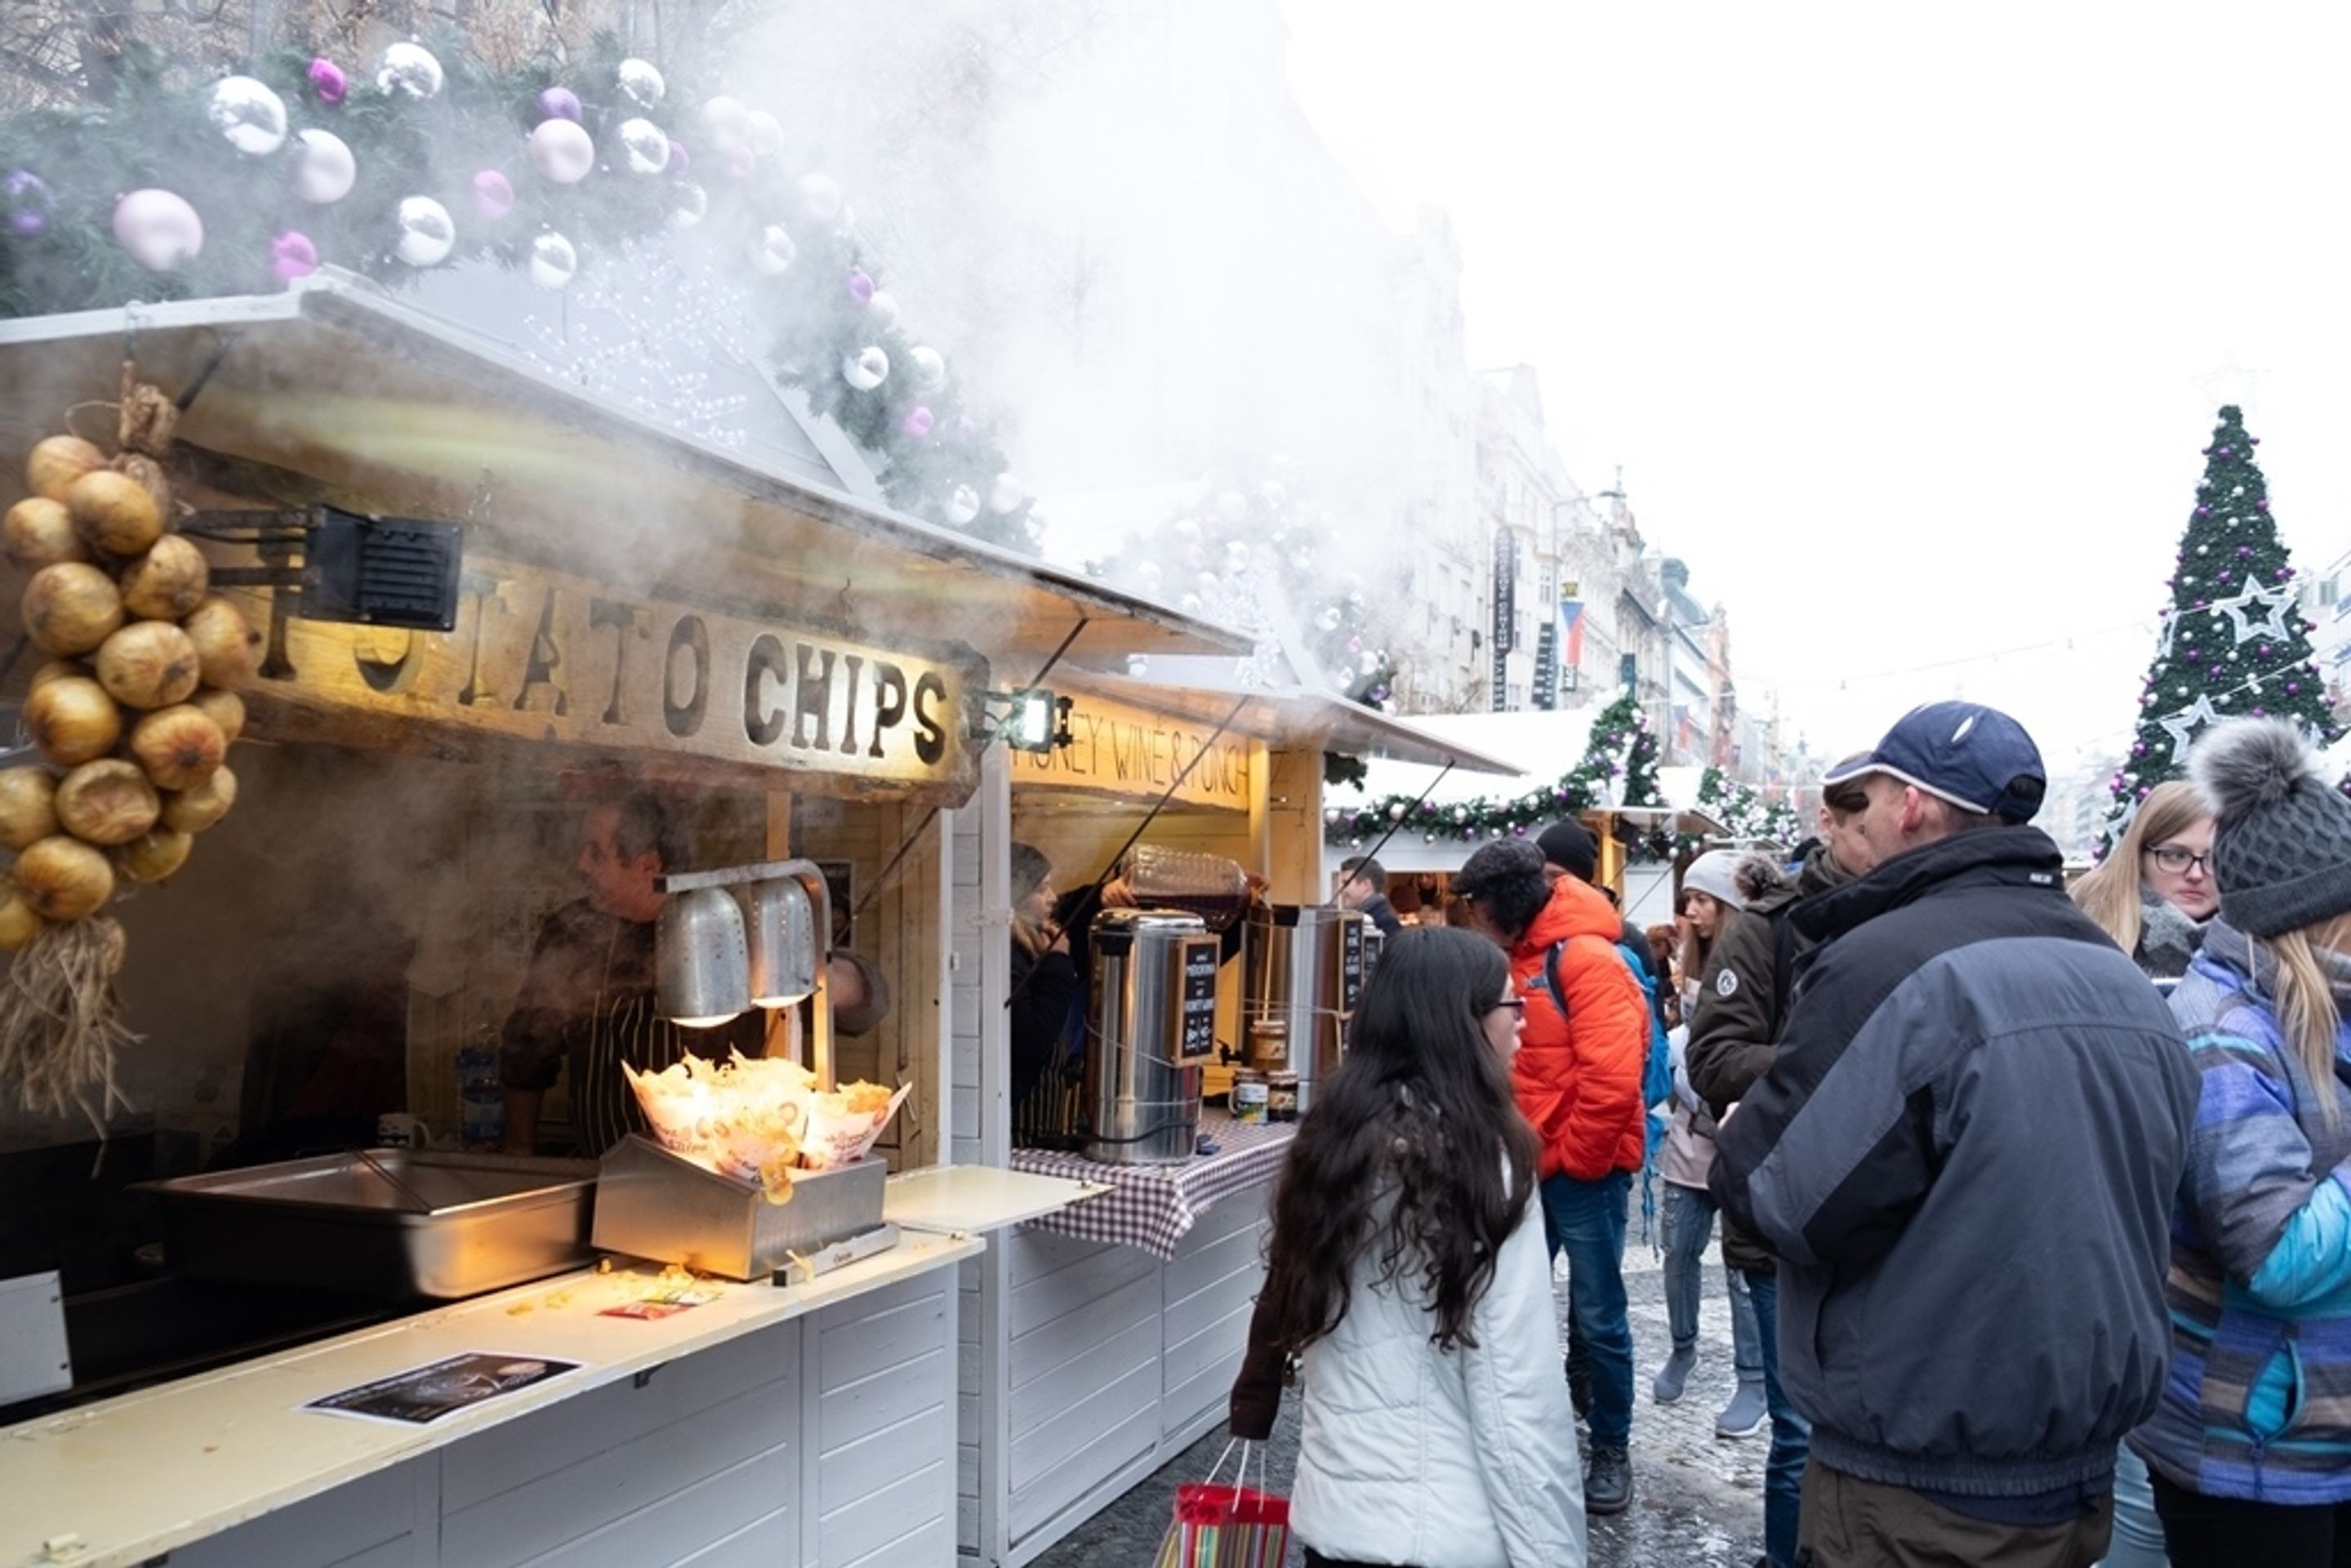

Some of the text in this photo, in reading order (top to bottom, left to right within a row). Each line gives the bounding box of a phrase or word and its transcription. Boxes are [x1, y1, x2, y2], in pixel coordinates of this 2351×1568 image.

[257, 572, 946, 766] TATO CHIPS
[1111, 721, 1165, 786] WINE
[1171, 729, 1186, 786] &
